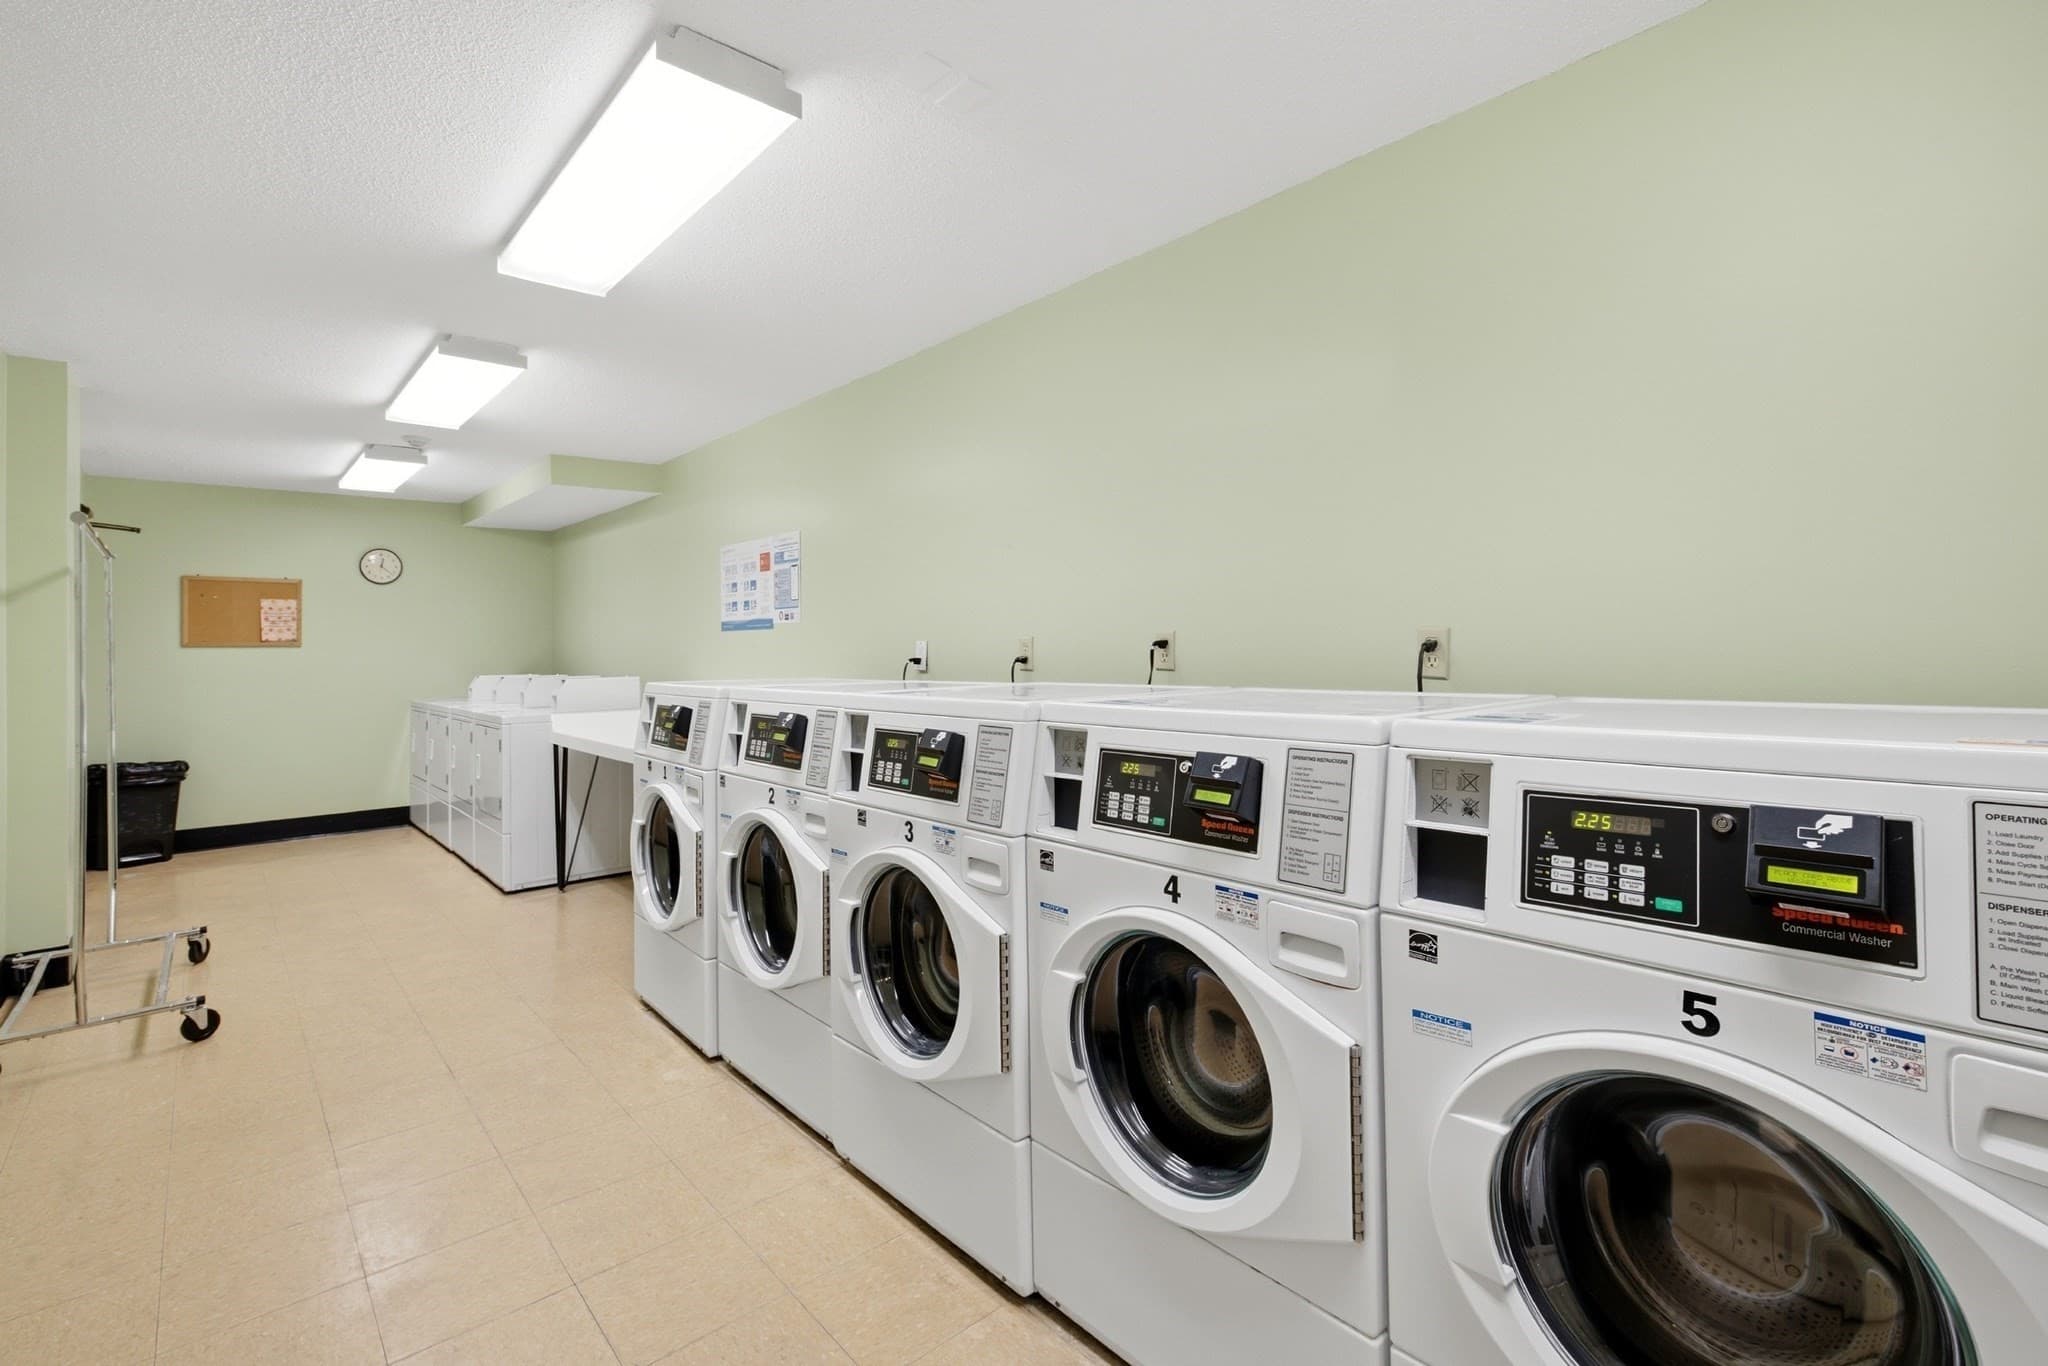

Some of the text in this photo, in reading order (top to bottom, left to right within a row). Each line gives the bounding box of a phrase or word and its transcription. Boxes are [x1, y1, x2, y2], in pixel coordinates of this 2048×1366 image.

[769, 787, 775, 804] 2
[1574, 812, 1611, 830] 2.25
[1985, 813, 2048, 825] OPERATING
[905, 821, 914, 842] 3
[1164, 875, 1181, 904] 4
[1782, 921, 1893, 949] Commercial Washer
[1420, 1012, 1464, 1028] NOTICE
[1680, 990, 1720, 1037] 5
[1849, 1020, 1887, 1033] NOTICE
